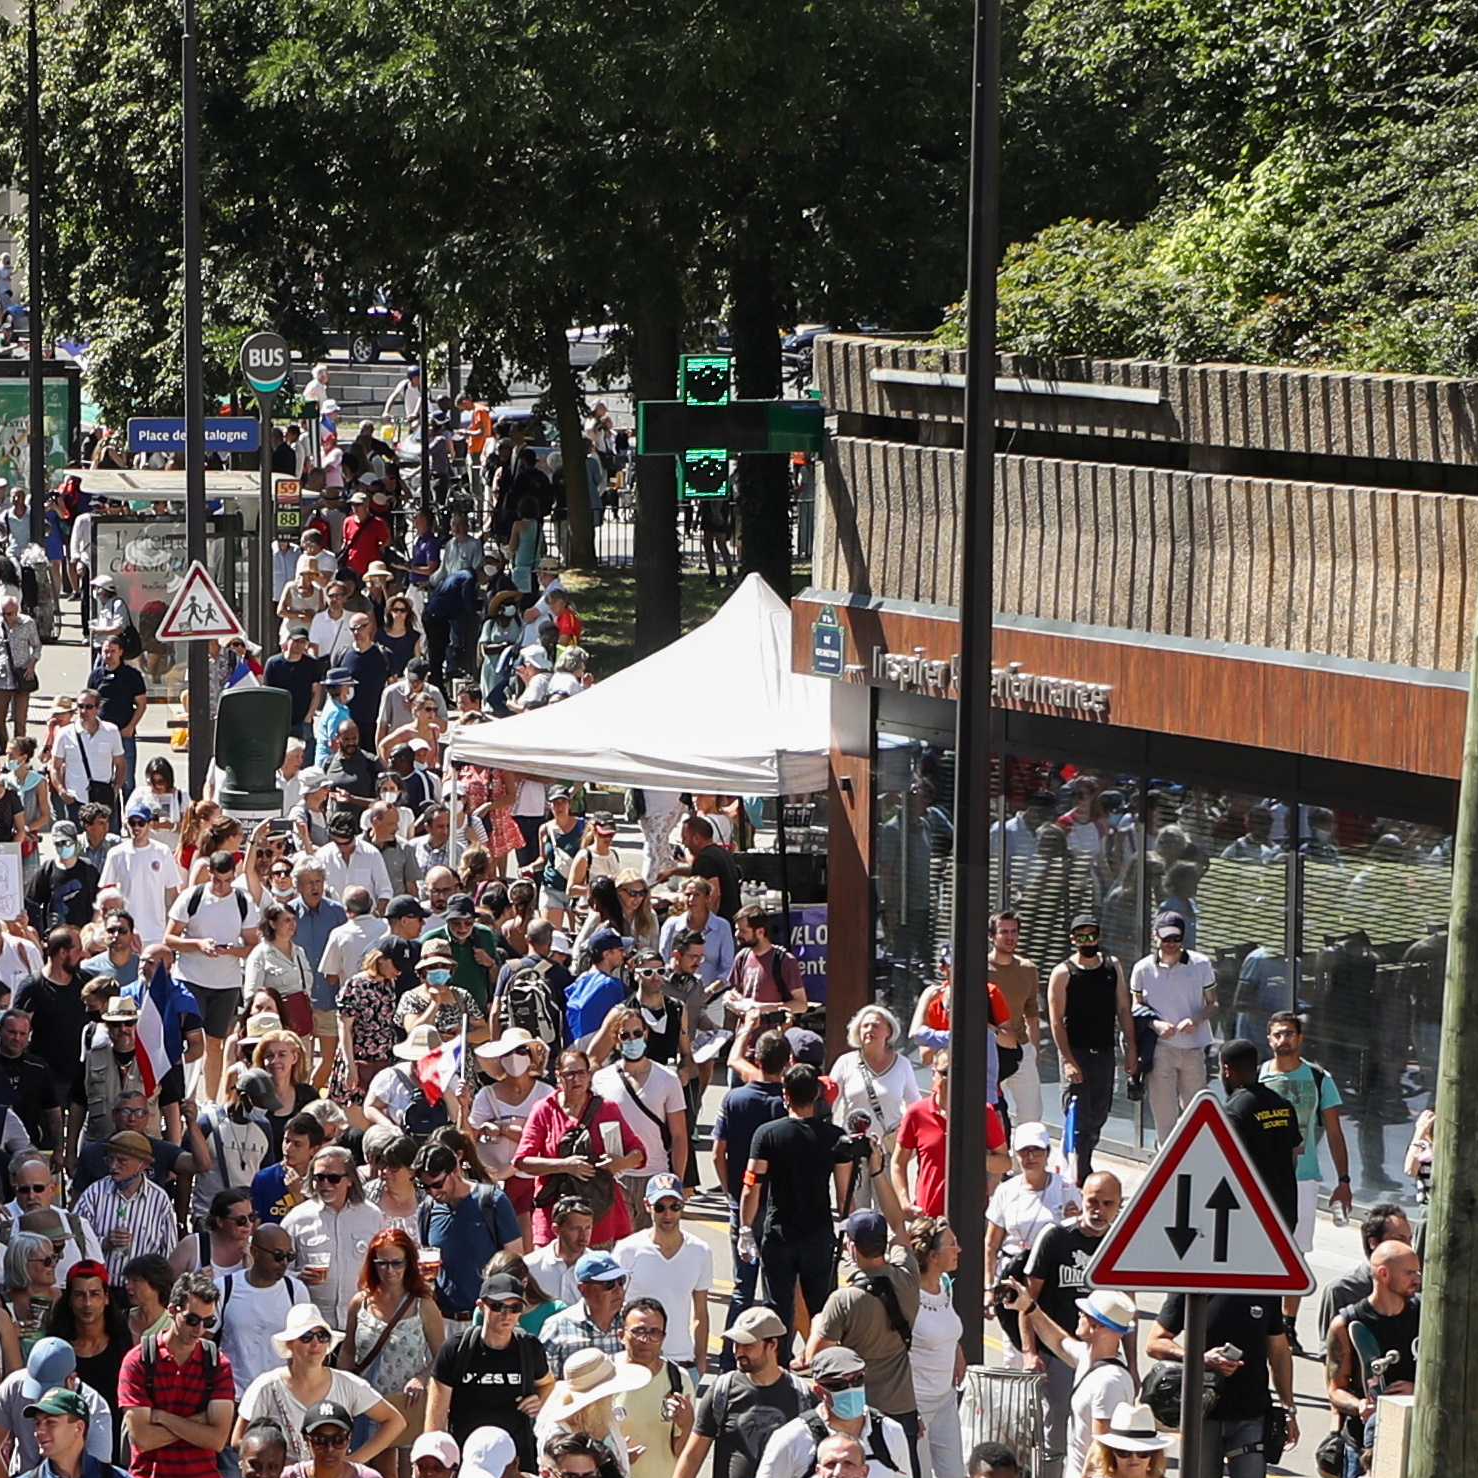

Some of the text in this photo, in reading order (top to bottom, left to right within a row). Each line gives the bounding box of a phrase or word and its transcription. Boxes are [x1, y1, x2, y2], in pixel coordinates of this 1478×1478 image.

[249, 349, 284, 367] BUS
[139, 430, 248, 444] Place de talogne
[279, 483, 298, 494] 59
[279, 512, 298, 526] 88
[873, 646, 949, 691] Inspirer
[992, 662, 1110, 711] erformance
